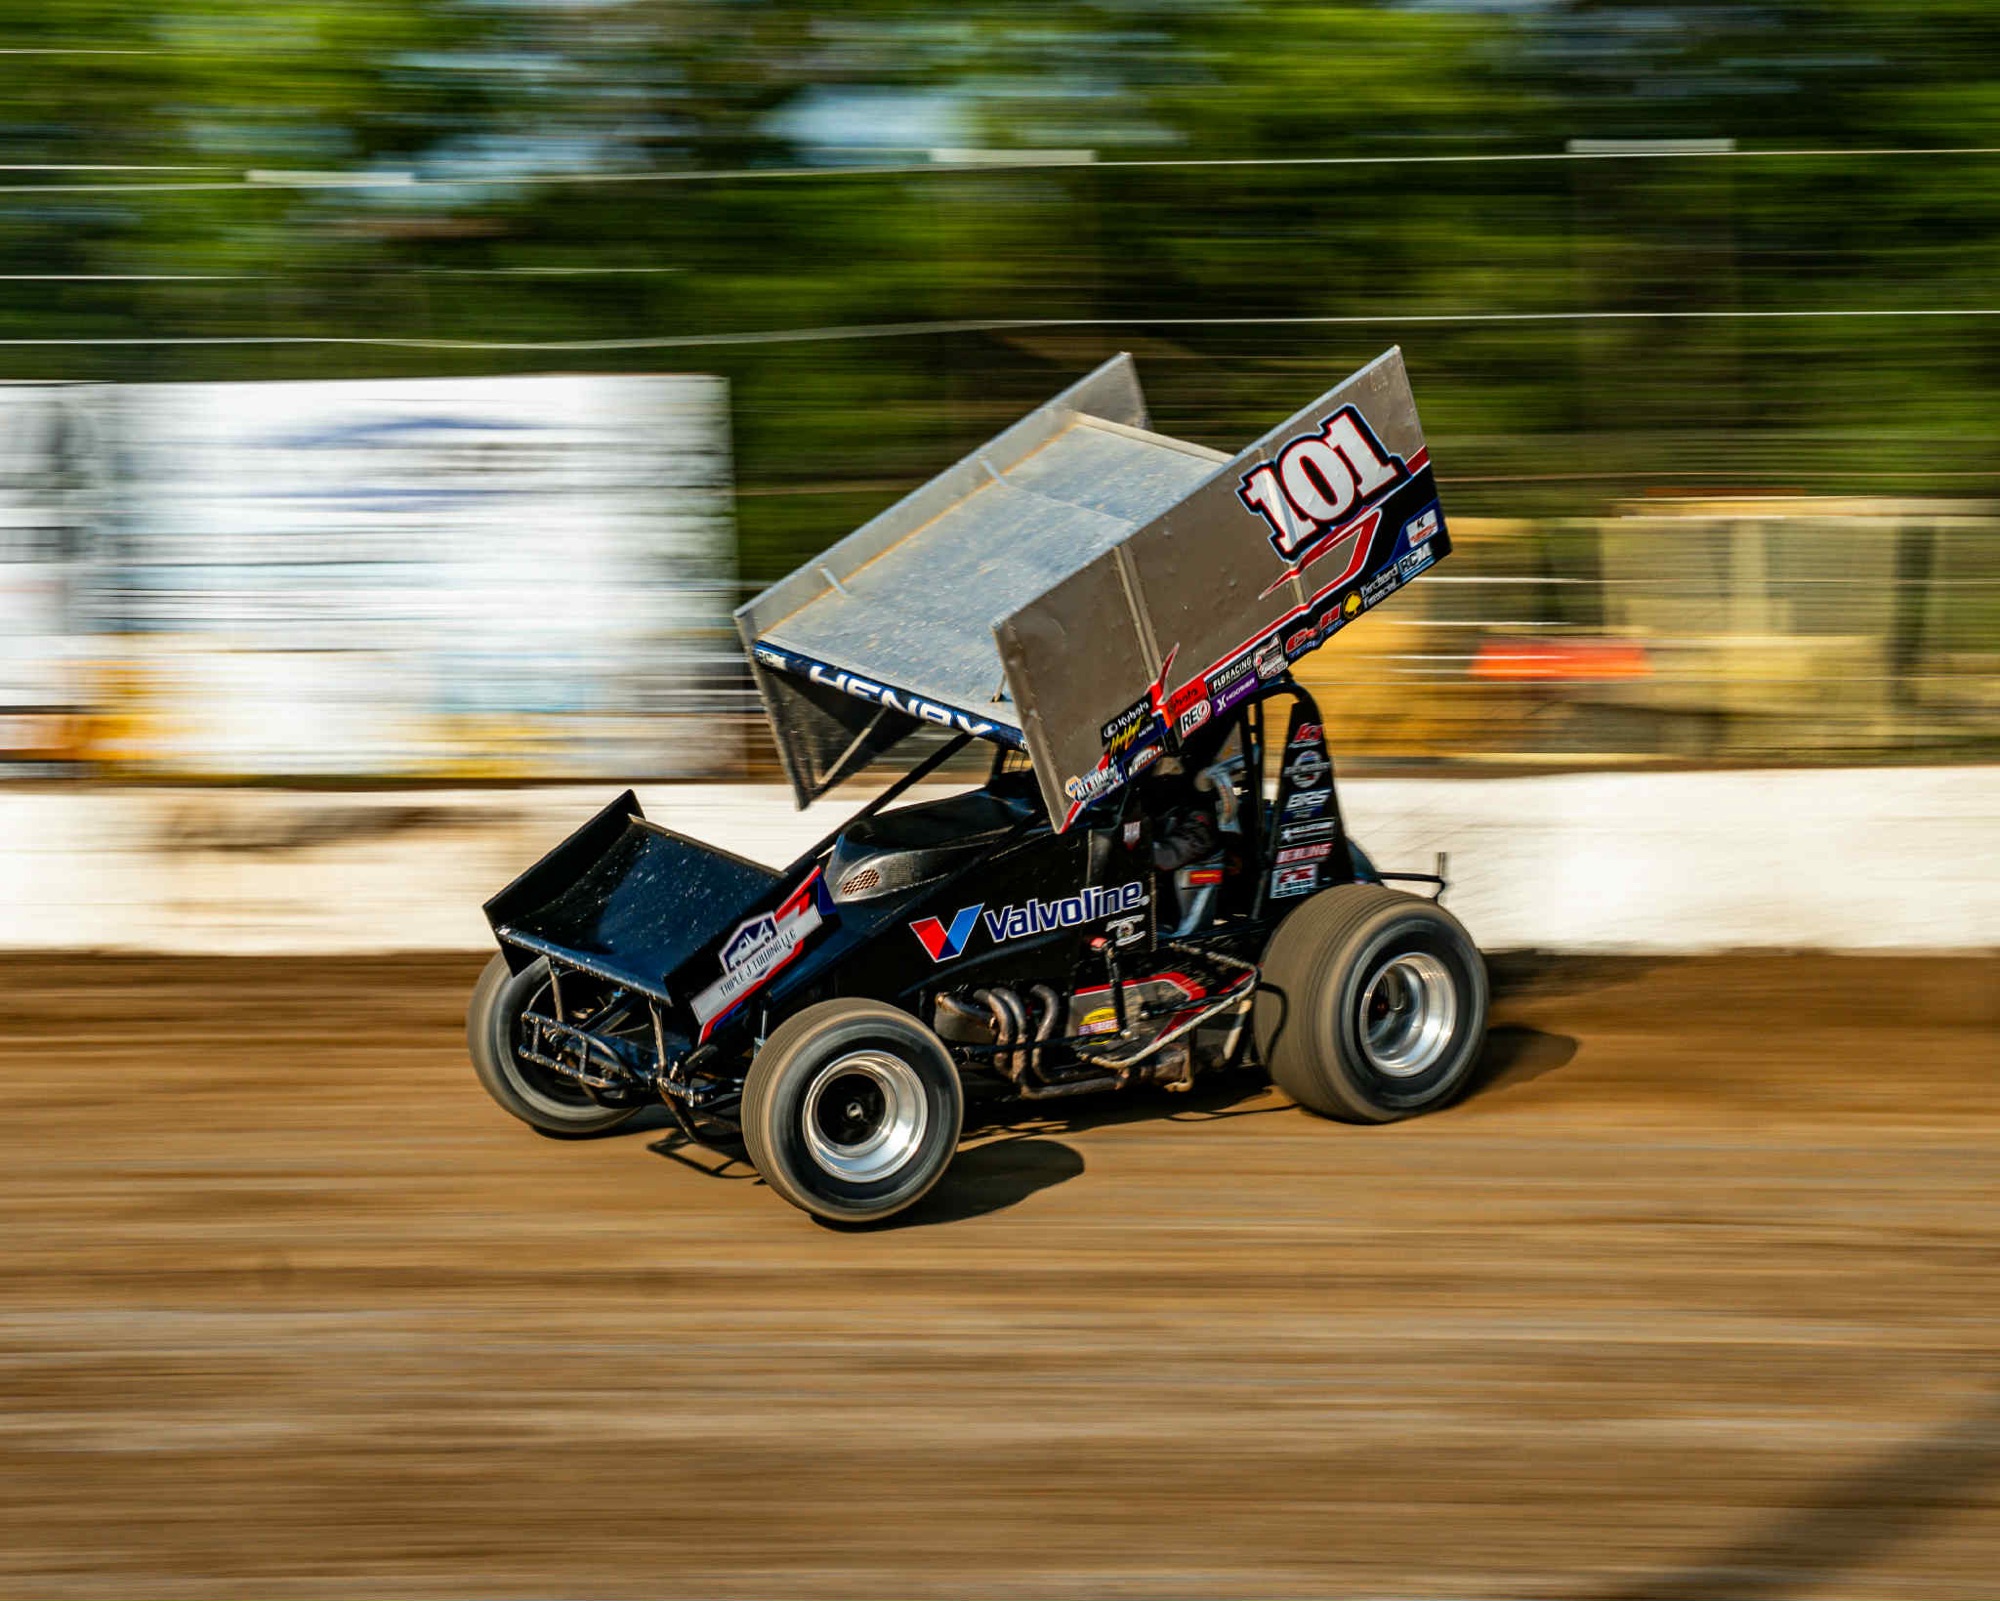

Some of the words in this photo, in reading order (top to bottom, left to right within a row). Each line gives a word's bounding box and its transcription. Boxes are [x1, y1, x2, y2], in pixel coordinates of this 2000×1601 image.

[1237, 404, 1411, 561] 101
[1117, 701, 1149, 727] Kubota
[984, 881, 1143, 943] Valvoline
